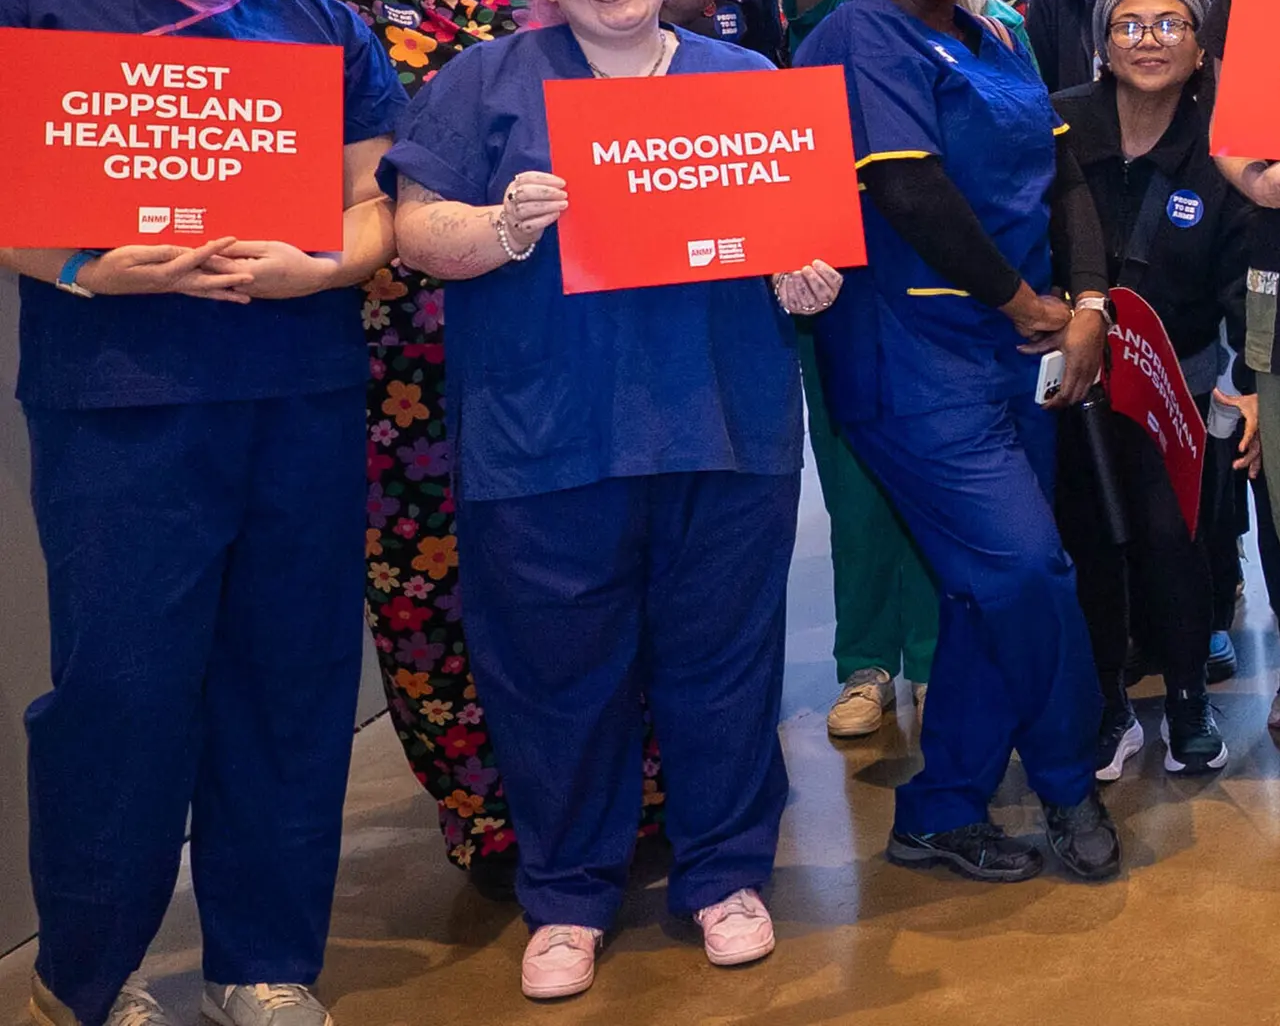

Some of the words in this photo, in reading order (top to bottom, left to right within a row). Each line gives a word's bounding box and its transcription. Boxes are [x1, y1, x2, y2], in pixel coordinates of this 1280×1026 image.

[120, 62, 230, 91] WEST
[61, 91, 282, 123] GIPPSLAND
[45, 121, 297, 154] HEALTHCARE
[592, 128, 815, 166] MAROONDAH
[103, 154, 242, 182] GROUP
[627, 159, 791, 194] HOSPITAL
[691, 248, 713, 256] ANMF
[1107, 324, 1197, 459] ANDRINGHAM
